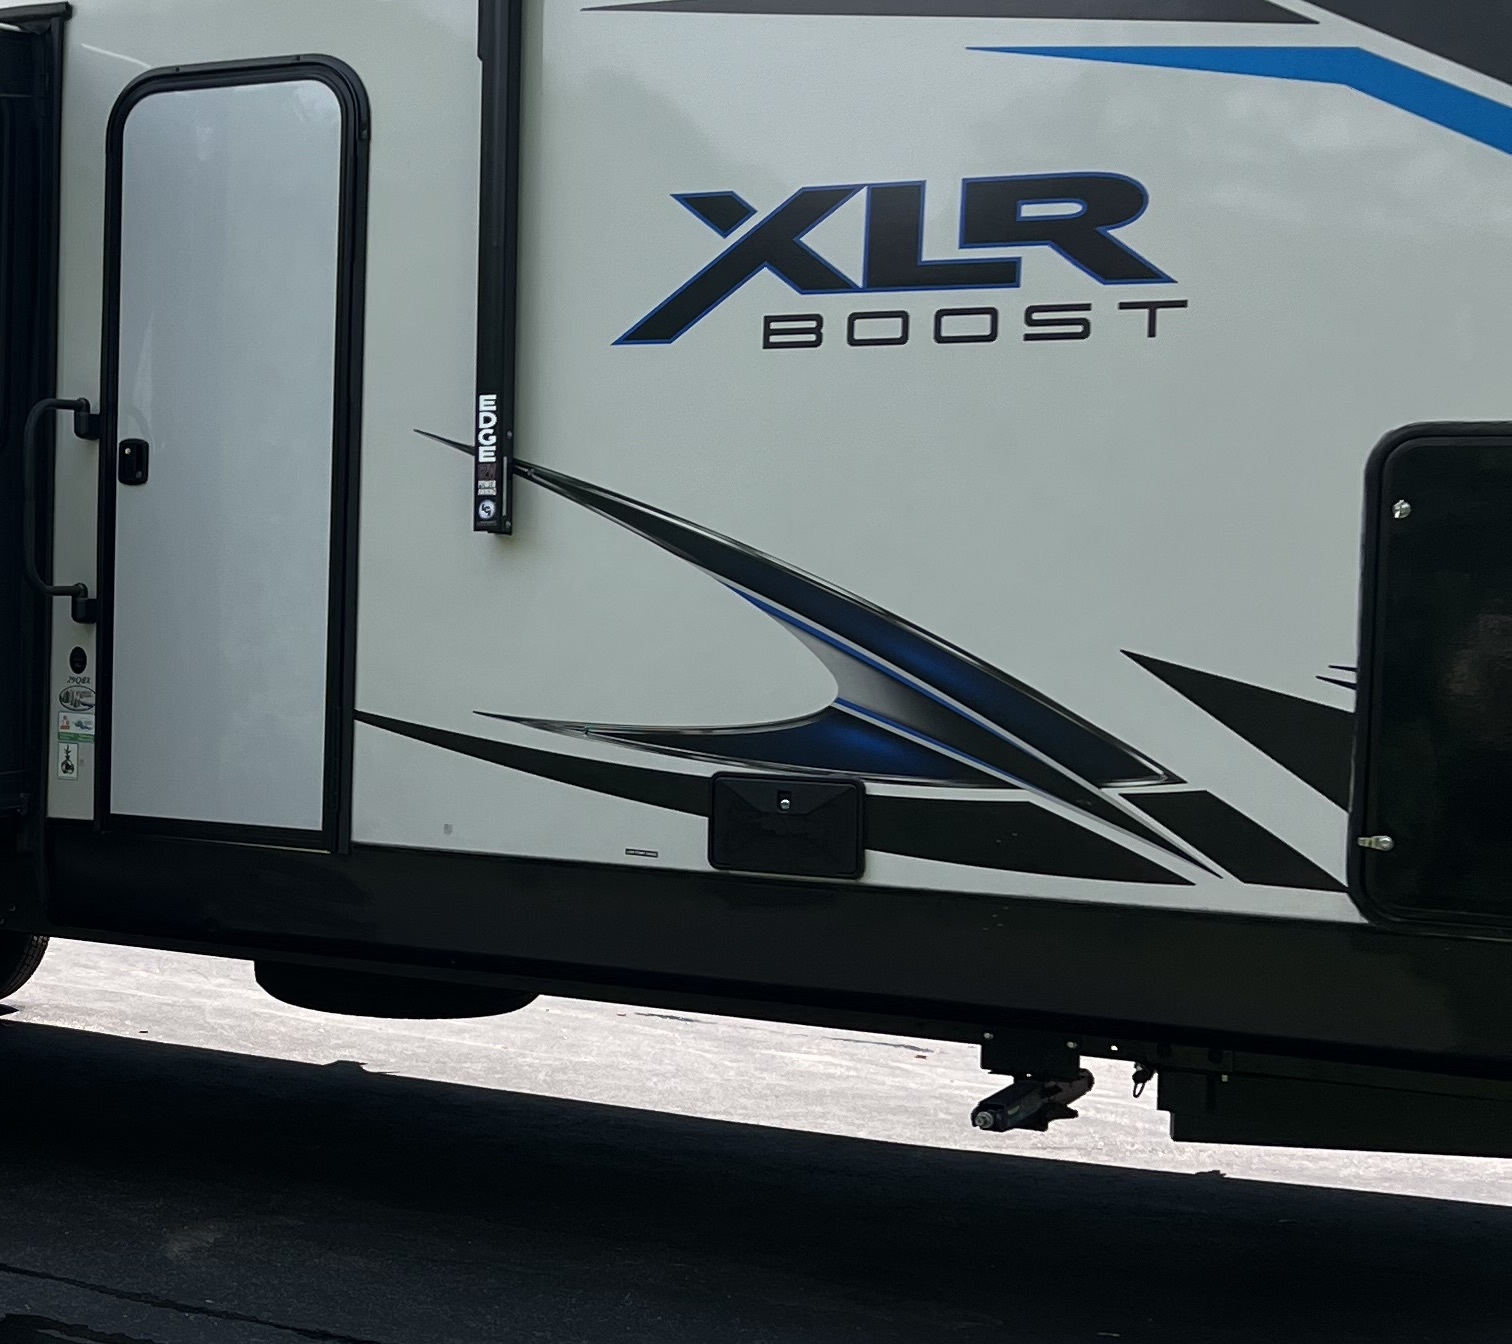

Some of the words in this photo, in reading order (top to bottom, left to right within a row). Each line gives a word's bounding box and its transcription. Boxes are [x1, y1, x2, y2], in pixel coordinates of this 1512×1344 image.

[611, 171, 1179, 346] XLR
[762, 299, 1189, 350] BOOST
[477, 394, 498, 462] EDGE
